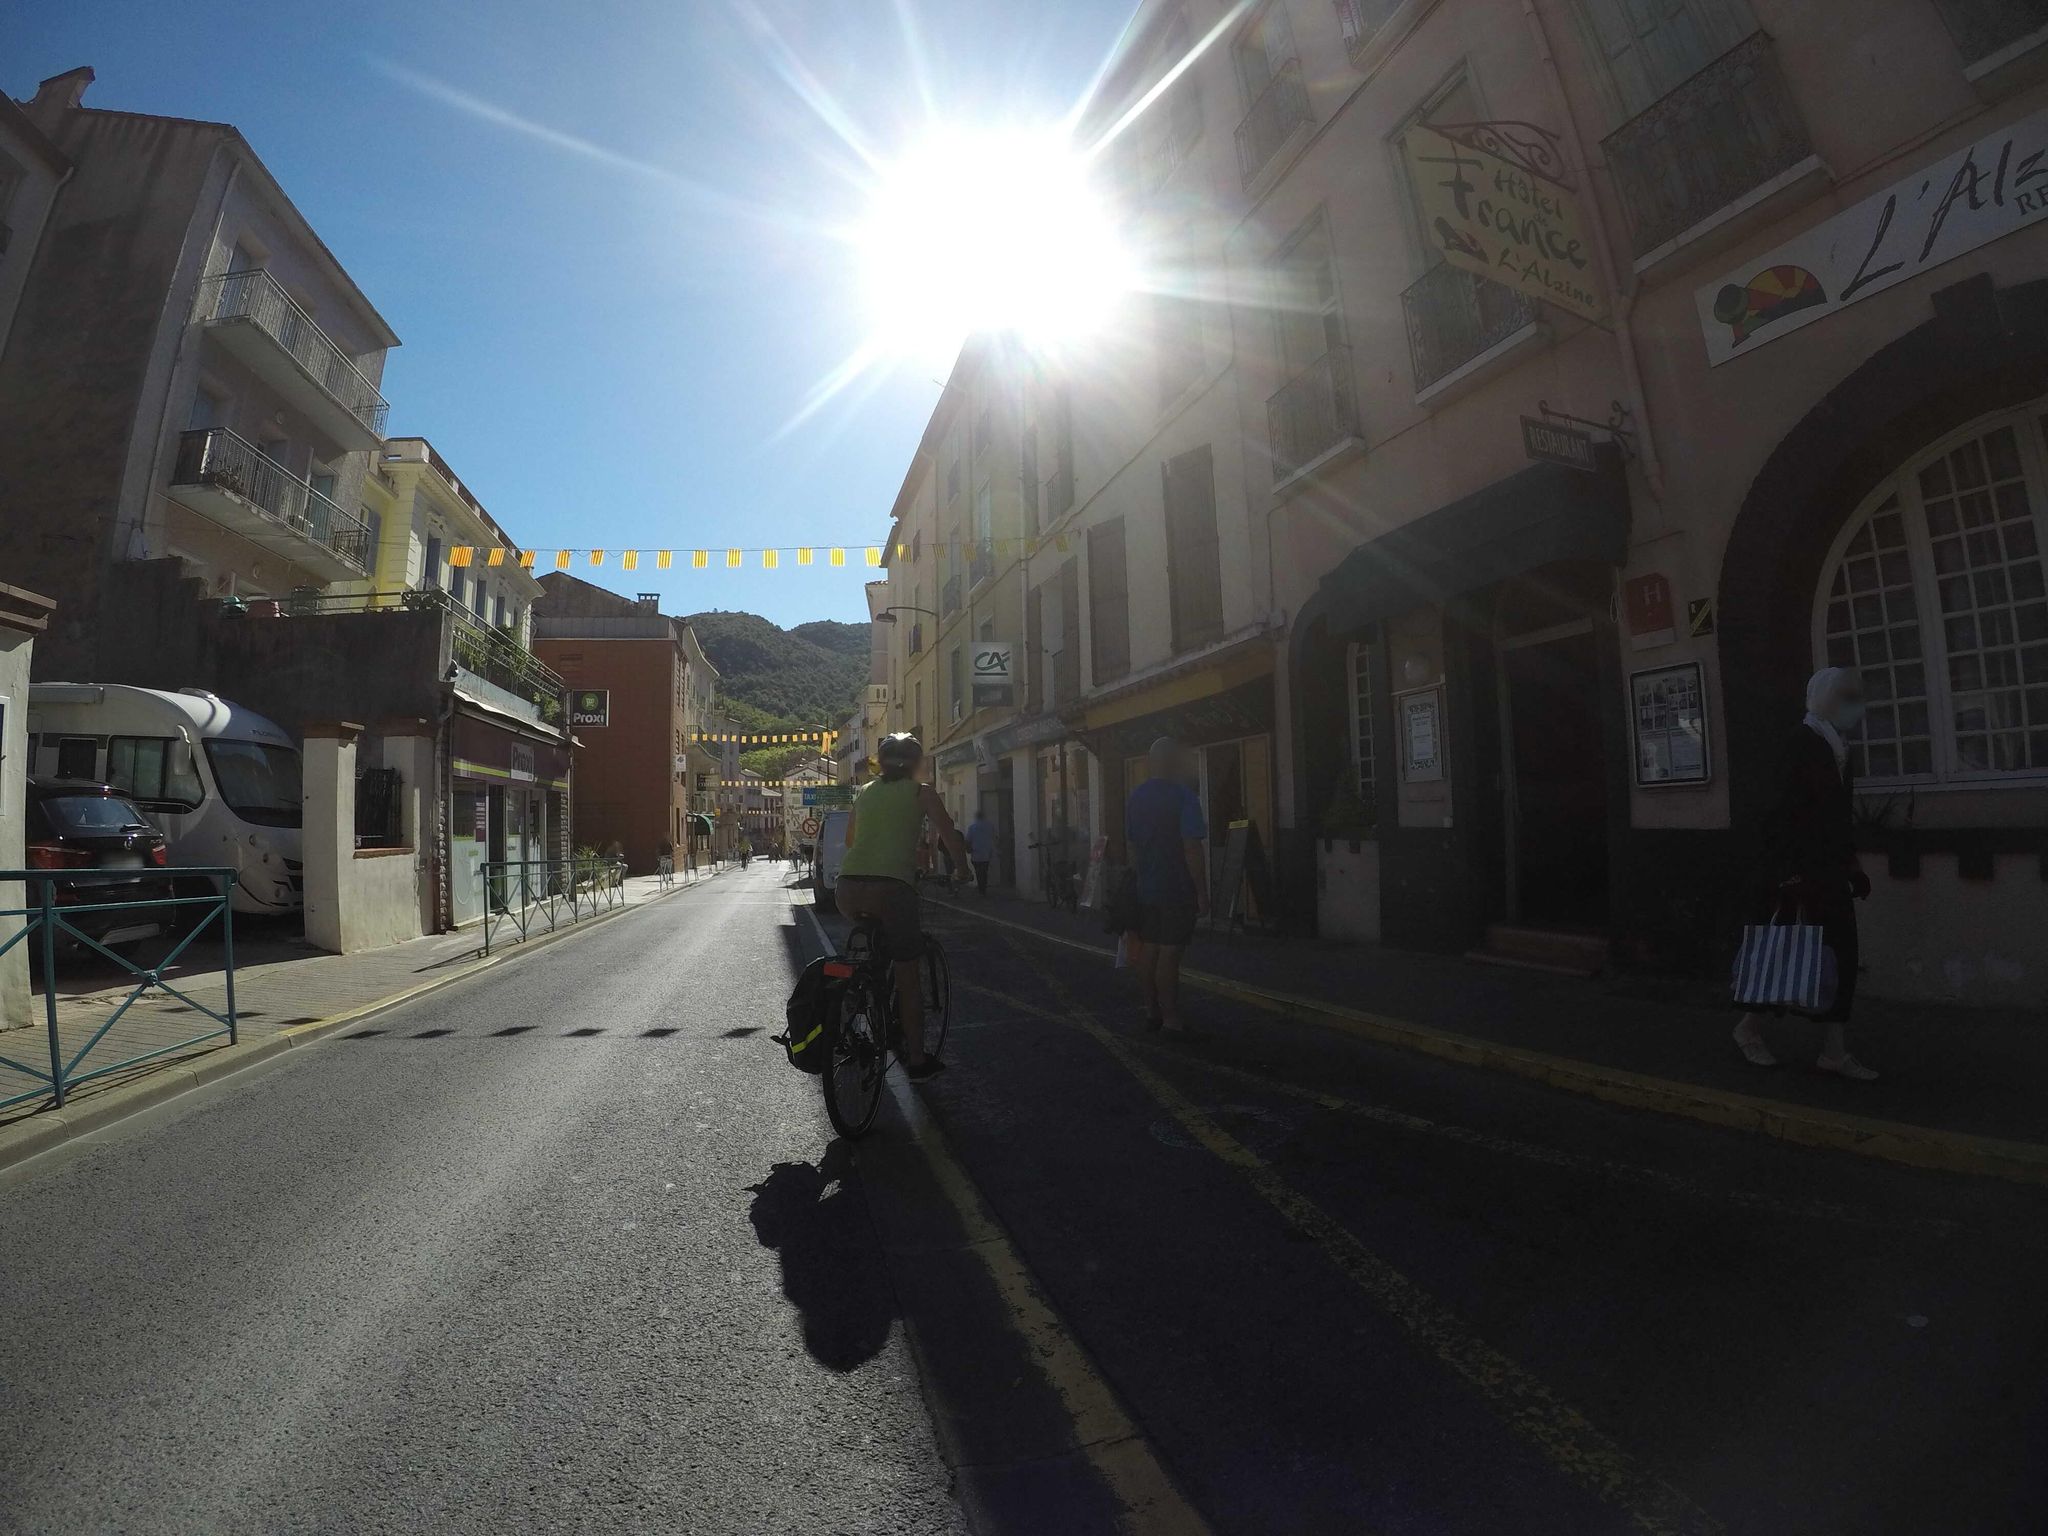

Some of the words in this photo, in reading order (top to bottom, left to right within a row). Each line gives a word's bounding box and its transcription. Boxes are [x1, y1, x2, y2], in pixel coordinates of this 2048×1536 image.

[1417, 145, 1588, 270] France
[1527, 425, 1590, 466] RESTAURANT
[1640, 582, 1662, 606] H
[573, 709, 605, 723] Proxi
